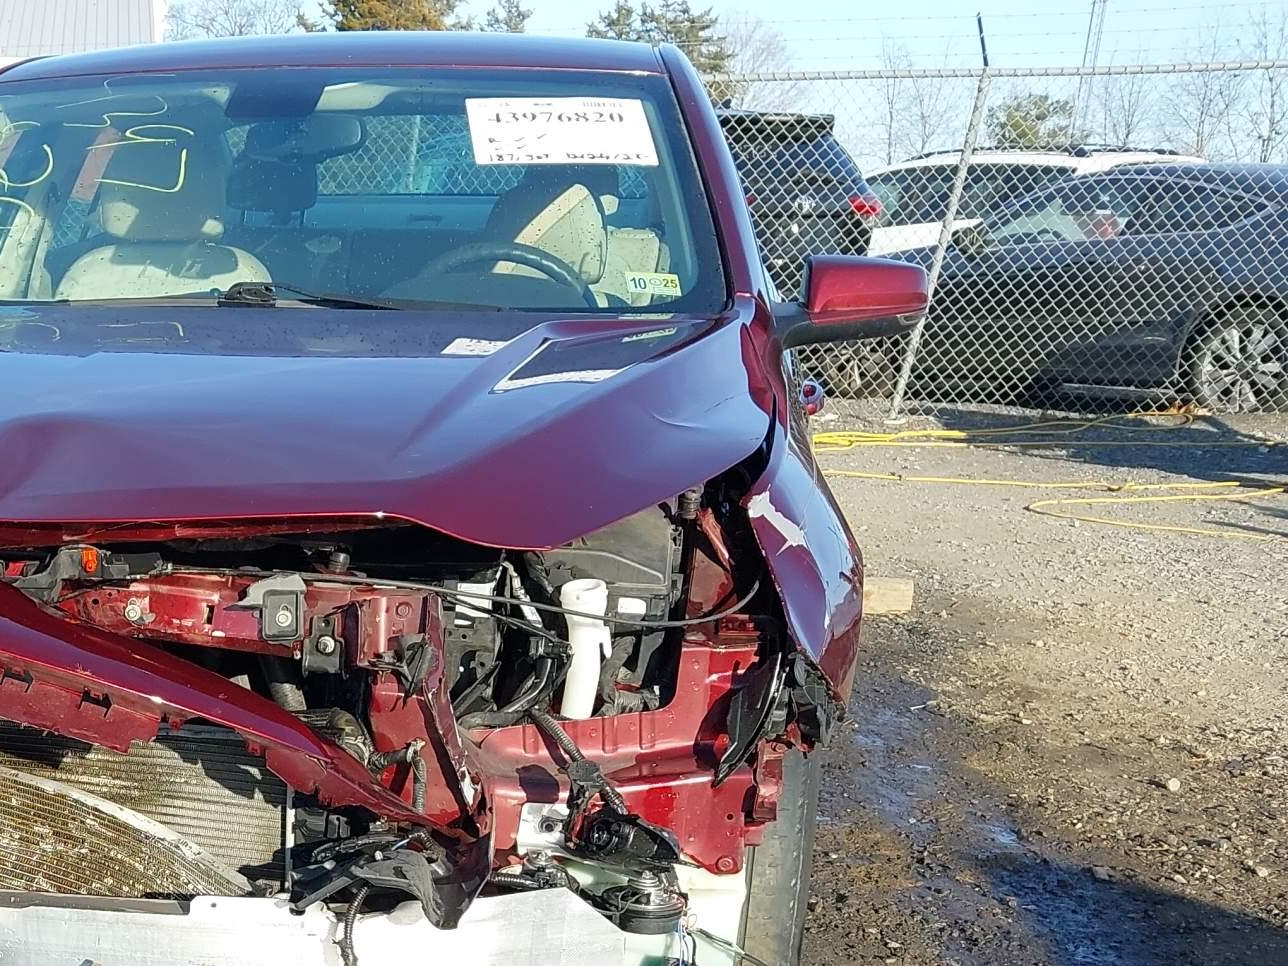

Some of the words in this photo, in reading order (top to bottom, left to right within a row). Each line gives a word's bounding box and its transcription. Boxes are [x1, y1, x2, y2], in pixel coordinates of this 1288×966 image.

[487, 110, 624, 124] 43976820
[629, 276, 648, 290] 10
[662, 277, 679, 289] 25
